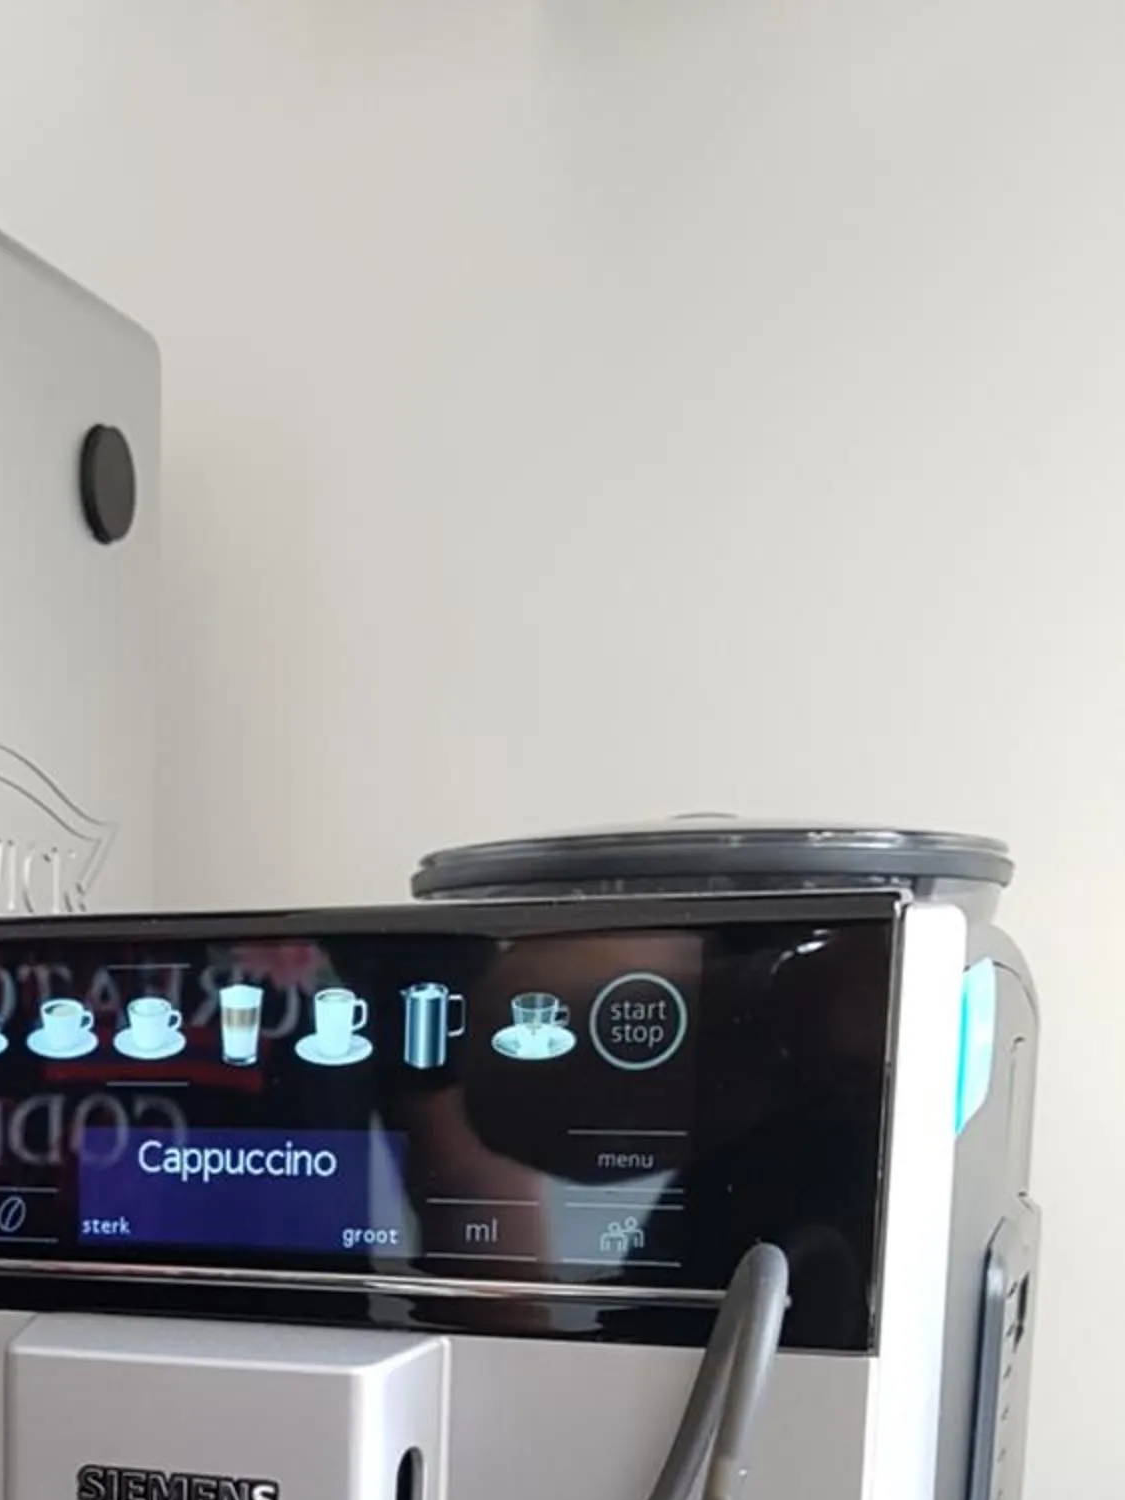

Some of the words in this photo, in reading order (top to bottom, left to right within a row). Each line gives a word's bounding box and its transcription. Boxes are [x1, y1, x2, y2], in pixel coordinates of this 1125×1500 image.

[610, 1001, 667, 1021] start
[611, 1023, 664, 1048] stop
[138, 1140, 337, 1182] Cappuccino
[597, 1152, 655, 1169] menu
[81, 1217, 131, 1235] sterk
[465, 1218, 499, 1243] ml
[342, 1227, 399, 1249] groot
